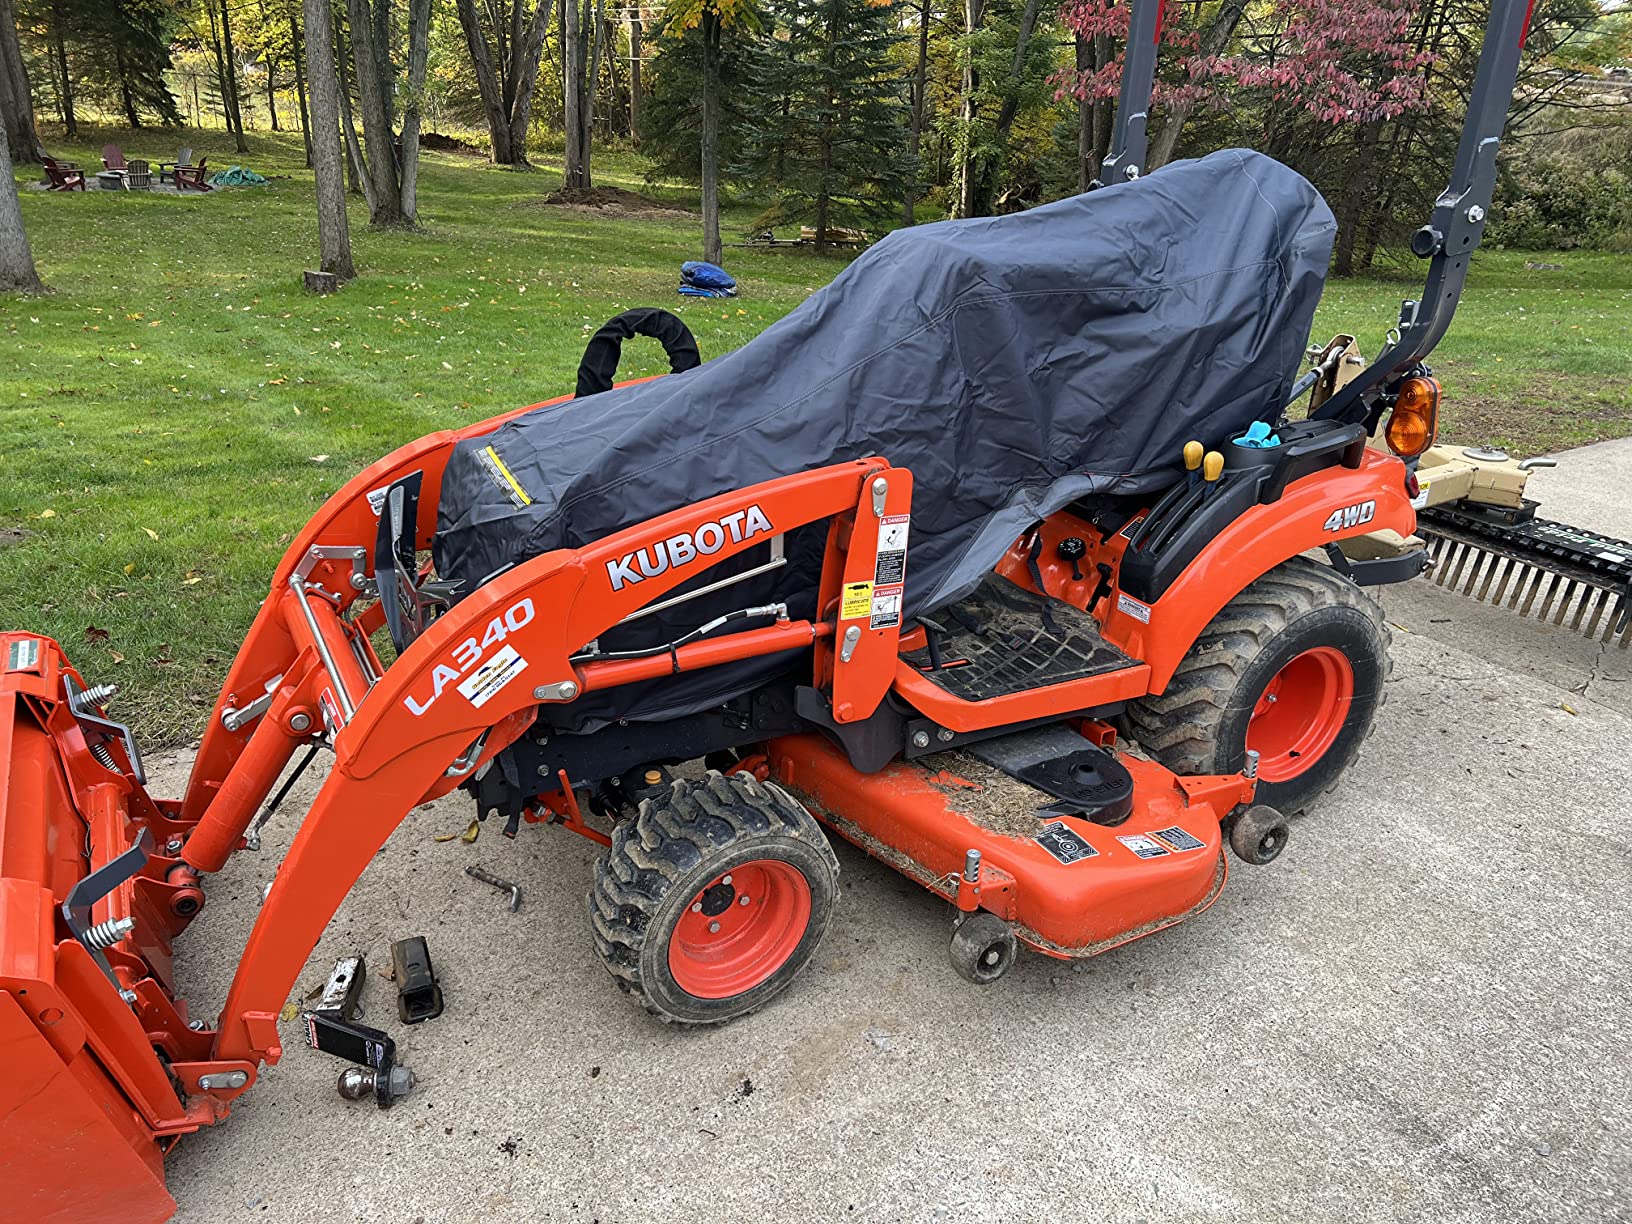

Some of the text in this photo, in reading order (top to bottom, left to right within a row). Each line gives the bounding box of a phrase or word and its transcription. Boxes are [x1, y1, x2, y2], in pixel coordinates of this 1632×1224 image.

[887, 516, 908, 524] DANGER
[1323, 499, 1376, 532] 4WD
[605, 504, 774, 592] KUBOTA
[880, 588, 901, 597] DANGER
[404, 597, 535, 716] LA340
